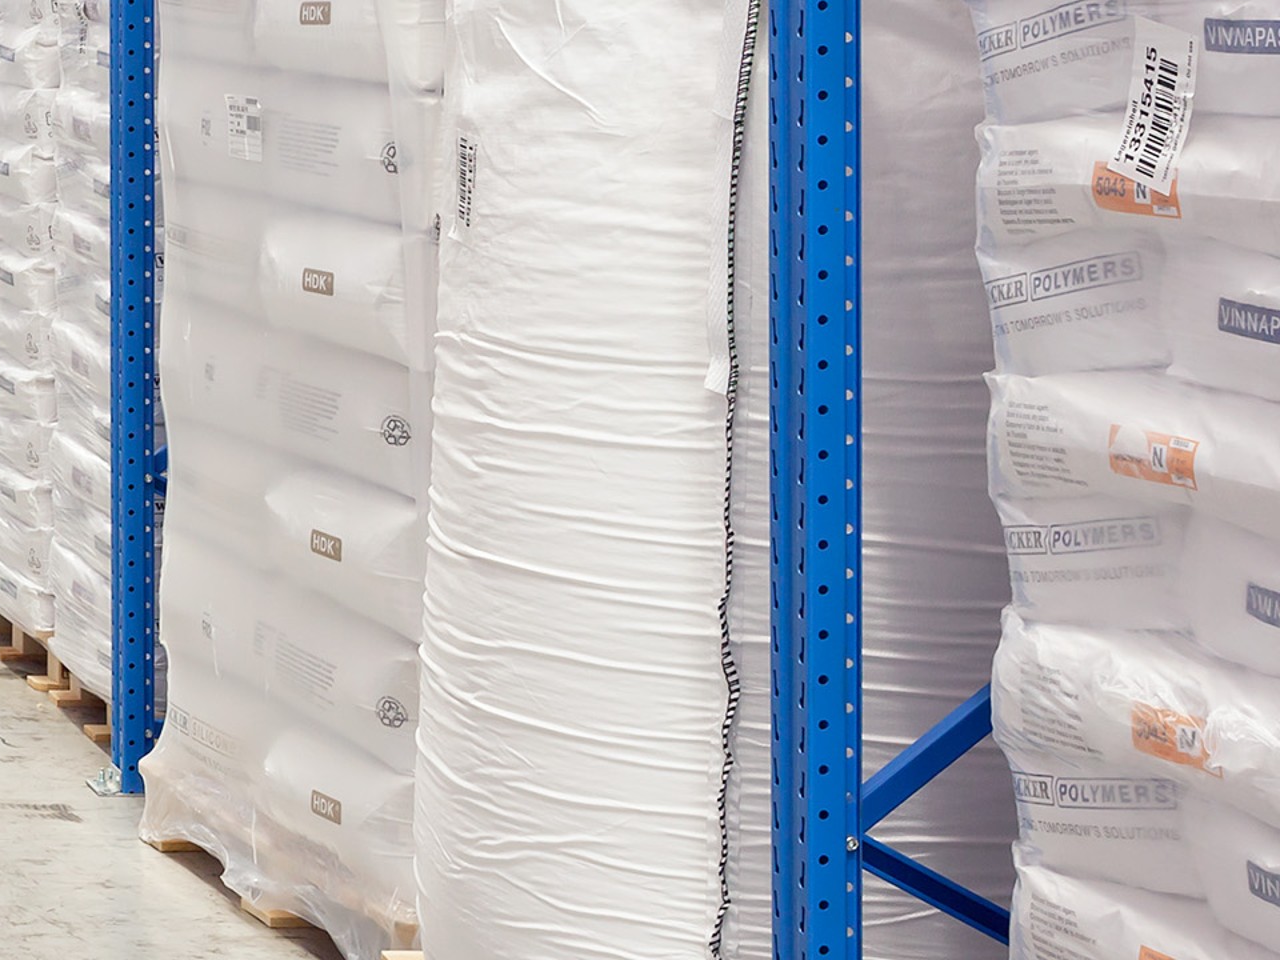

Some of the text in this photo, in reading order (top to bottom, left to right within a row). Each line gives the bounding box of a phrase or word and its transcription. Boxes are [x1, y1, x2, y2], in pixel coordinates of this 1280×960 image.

[302, 5, 325, 22] HDK
[1122, 45, 1158, 165] 13315415
[1113, 98, 1139, 163] Lagereinheit
[1095, 175, 1127, 198] 5043
[304, 271, 328, 291] HDK
[1032, 255, 1138, 296] POLYMERS
[1010, 308, 1073, 334] TOMORROW'S
[1152, 448, 1165, 468] N
[312, 533, 335, 557] HDK
[1052, 521, 1156, 549] POLYMERS
[312, 793, 335, 817] HDK
[1059, 781, 1169, 805] POLYMERS
[1039, 820, 1103, 839] TOMORROW'S
